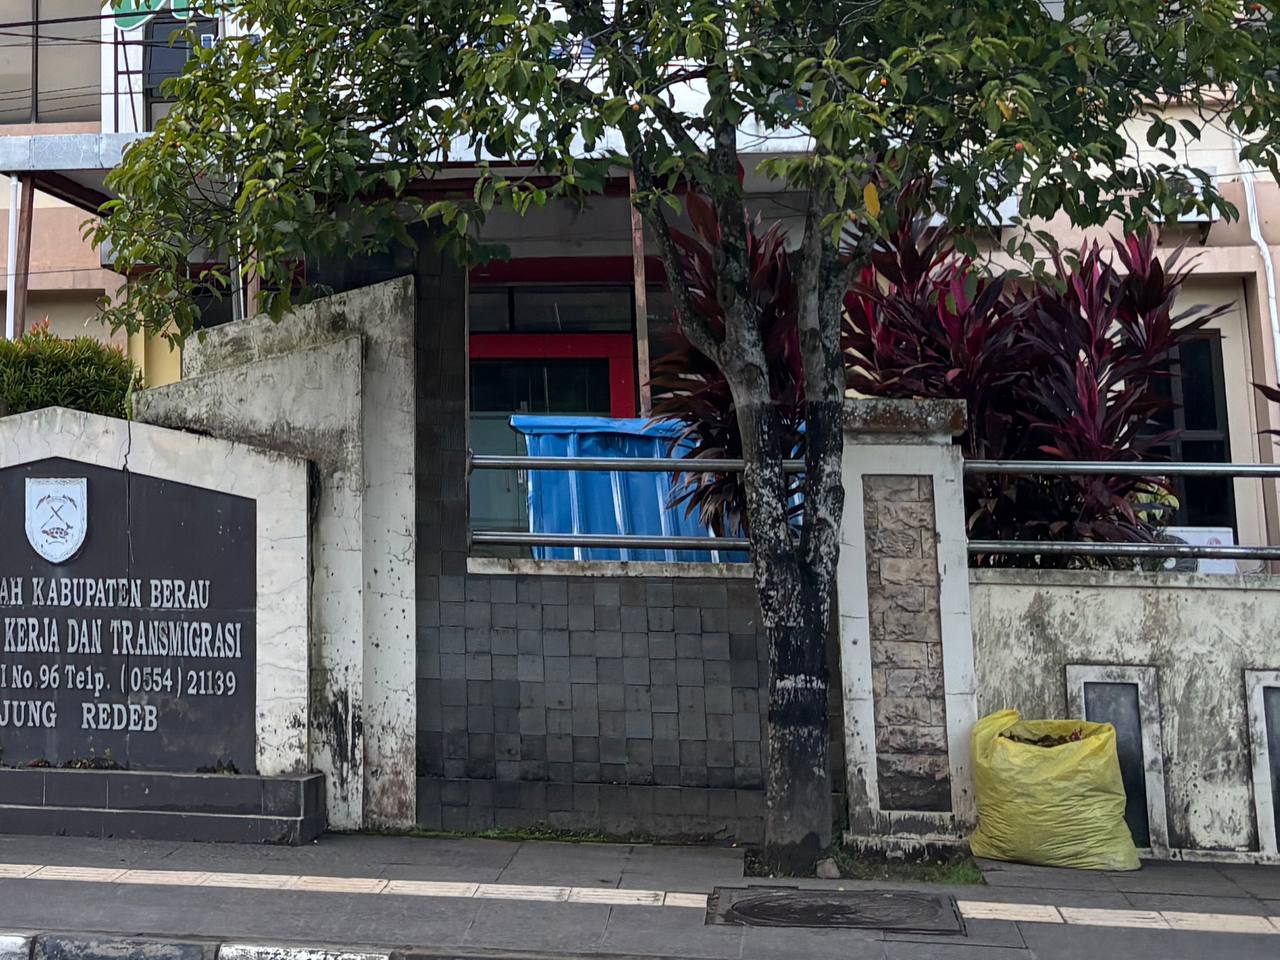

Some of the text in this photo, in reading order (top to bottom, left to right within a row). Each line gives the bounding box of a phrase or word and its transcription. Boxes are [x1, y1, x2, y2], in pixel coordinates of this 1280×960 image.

[32, 577, 142, 608] KABUPATEN
[150, 579, 210, 609] BERAU
[3, 617, 60, 653] KERJA
[67, 618, 102, 654] DAN
[110, 619, 242, 658] TRANSMIGRASI
[0, 664, 7, 688] I
[64, 664, 110, 697] Telp.
[187, 670, 236, 696] 21139
[81, 702, 158, 732] REDEB
